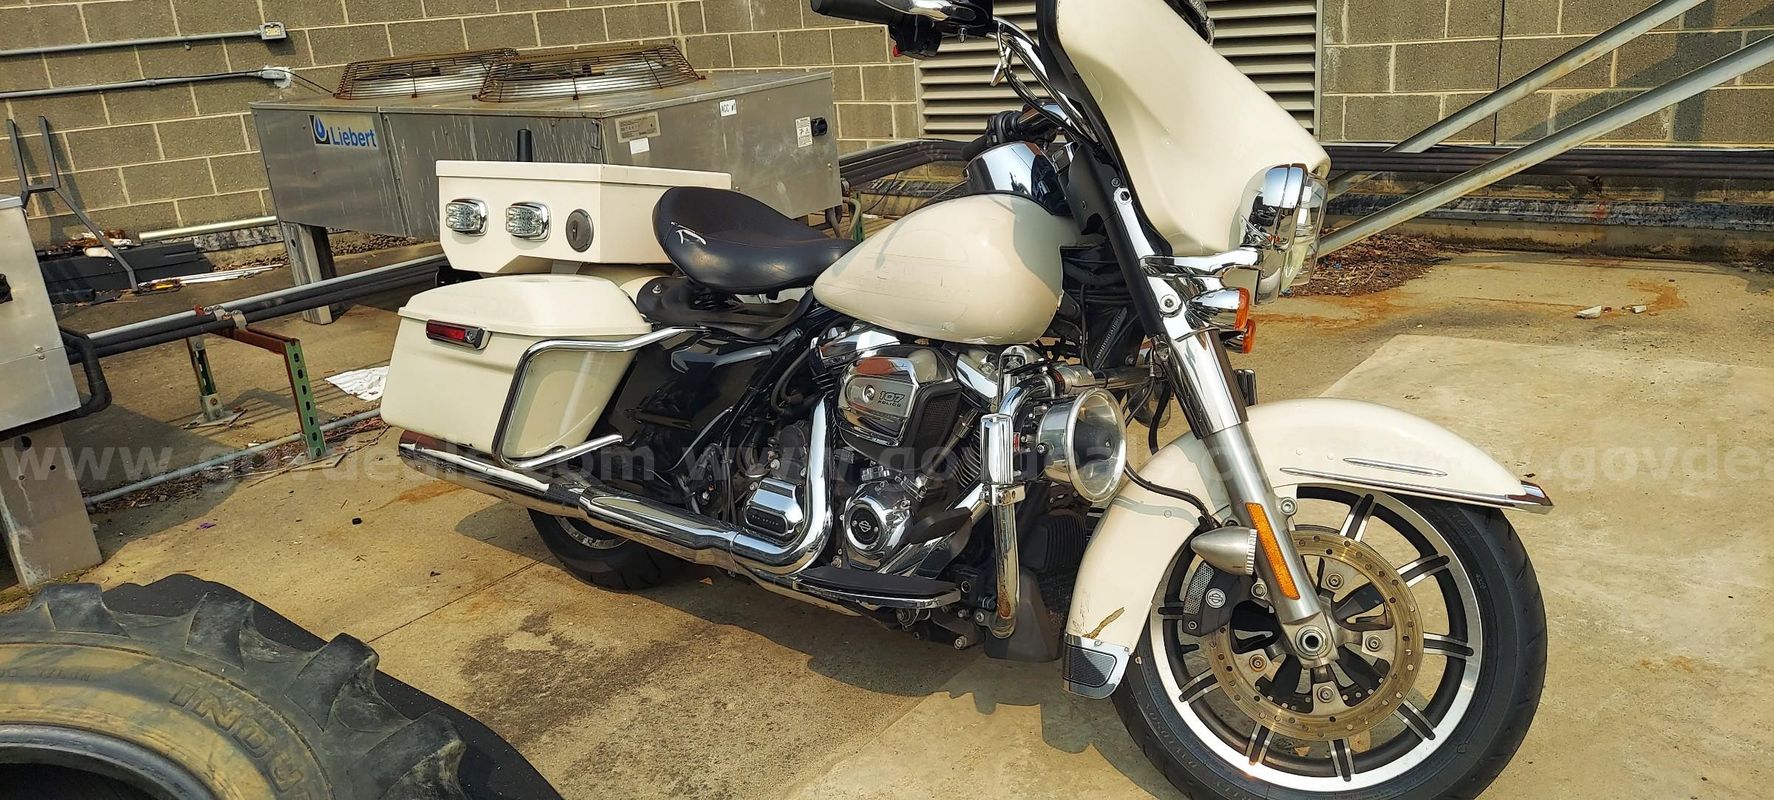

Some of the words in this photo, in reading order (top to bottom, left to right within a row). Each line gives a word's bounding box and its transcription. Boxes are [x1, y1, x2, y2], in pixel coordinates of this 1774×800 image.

[330, 126, 377, 148] Liebert
[879, 390, 905, 403] 107
[877, 400, 902, 408] POLICE
